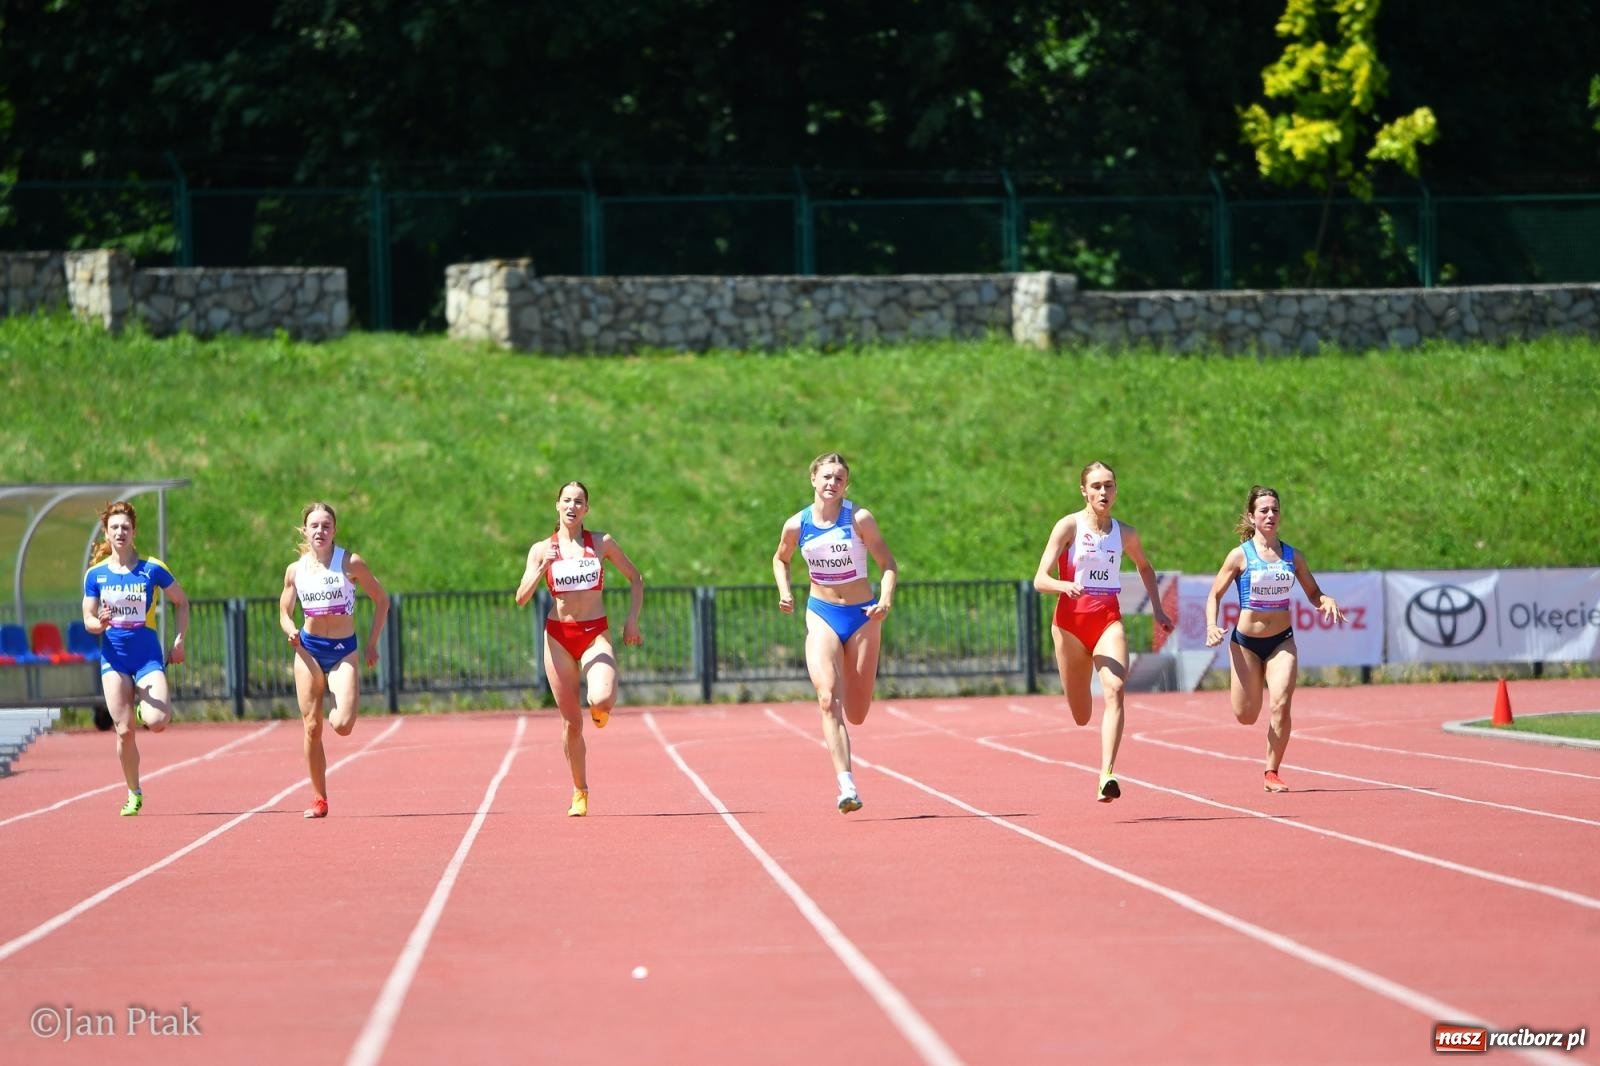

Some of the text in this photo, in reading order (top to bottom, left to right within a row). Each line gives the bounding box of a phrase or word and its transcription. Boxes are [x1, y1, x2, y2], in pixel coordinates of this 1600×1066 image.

[830, 543, 848, 553] 102
[578, 559, 595, 568] 204
[808, 556, 853, 568] MATYSOVÁ
[1108, 555, 1114, 564] 4
[1089, 569, 1109, 581] KUŚ
[1275, 573, 1290, 581] 501
[323, 576, 340, 585] 304
[125, 594, 142, 602] 404
[302, 588, 343, 602] JAROŠOVÁ
[1223, 600, 1366, 631] Rborz
[1508, 601, 1600, 634] Okęcie
